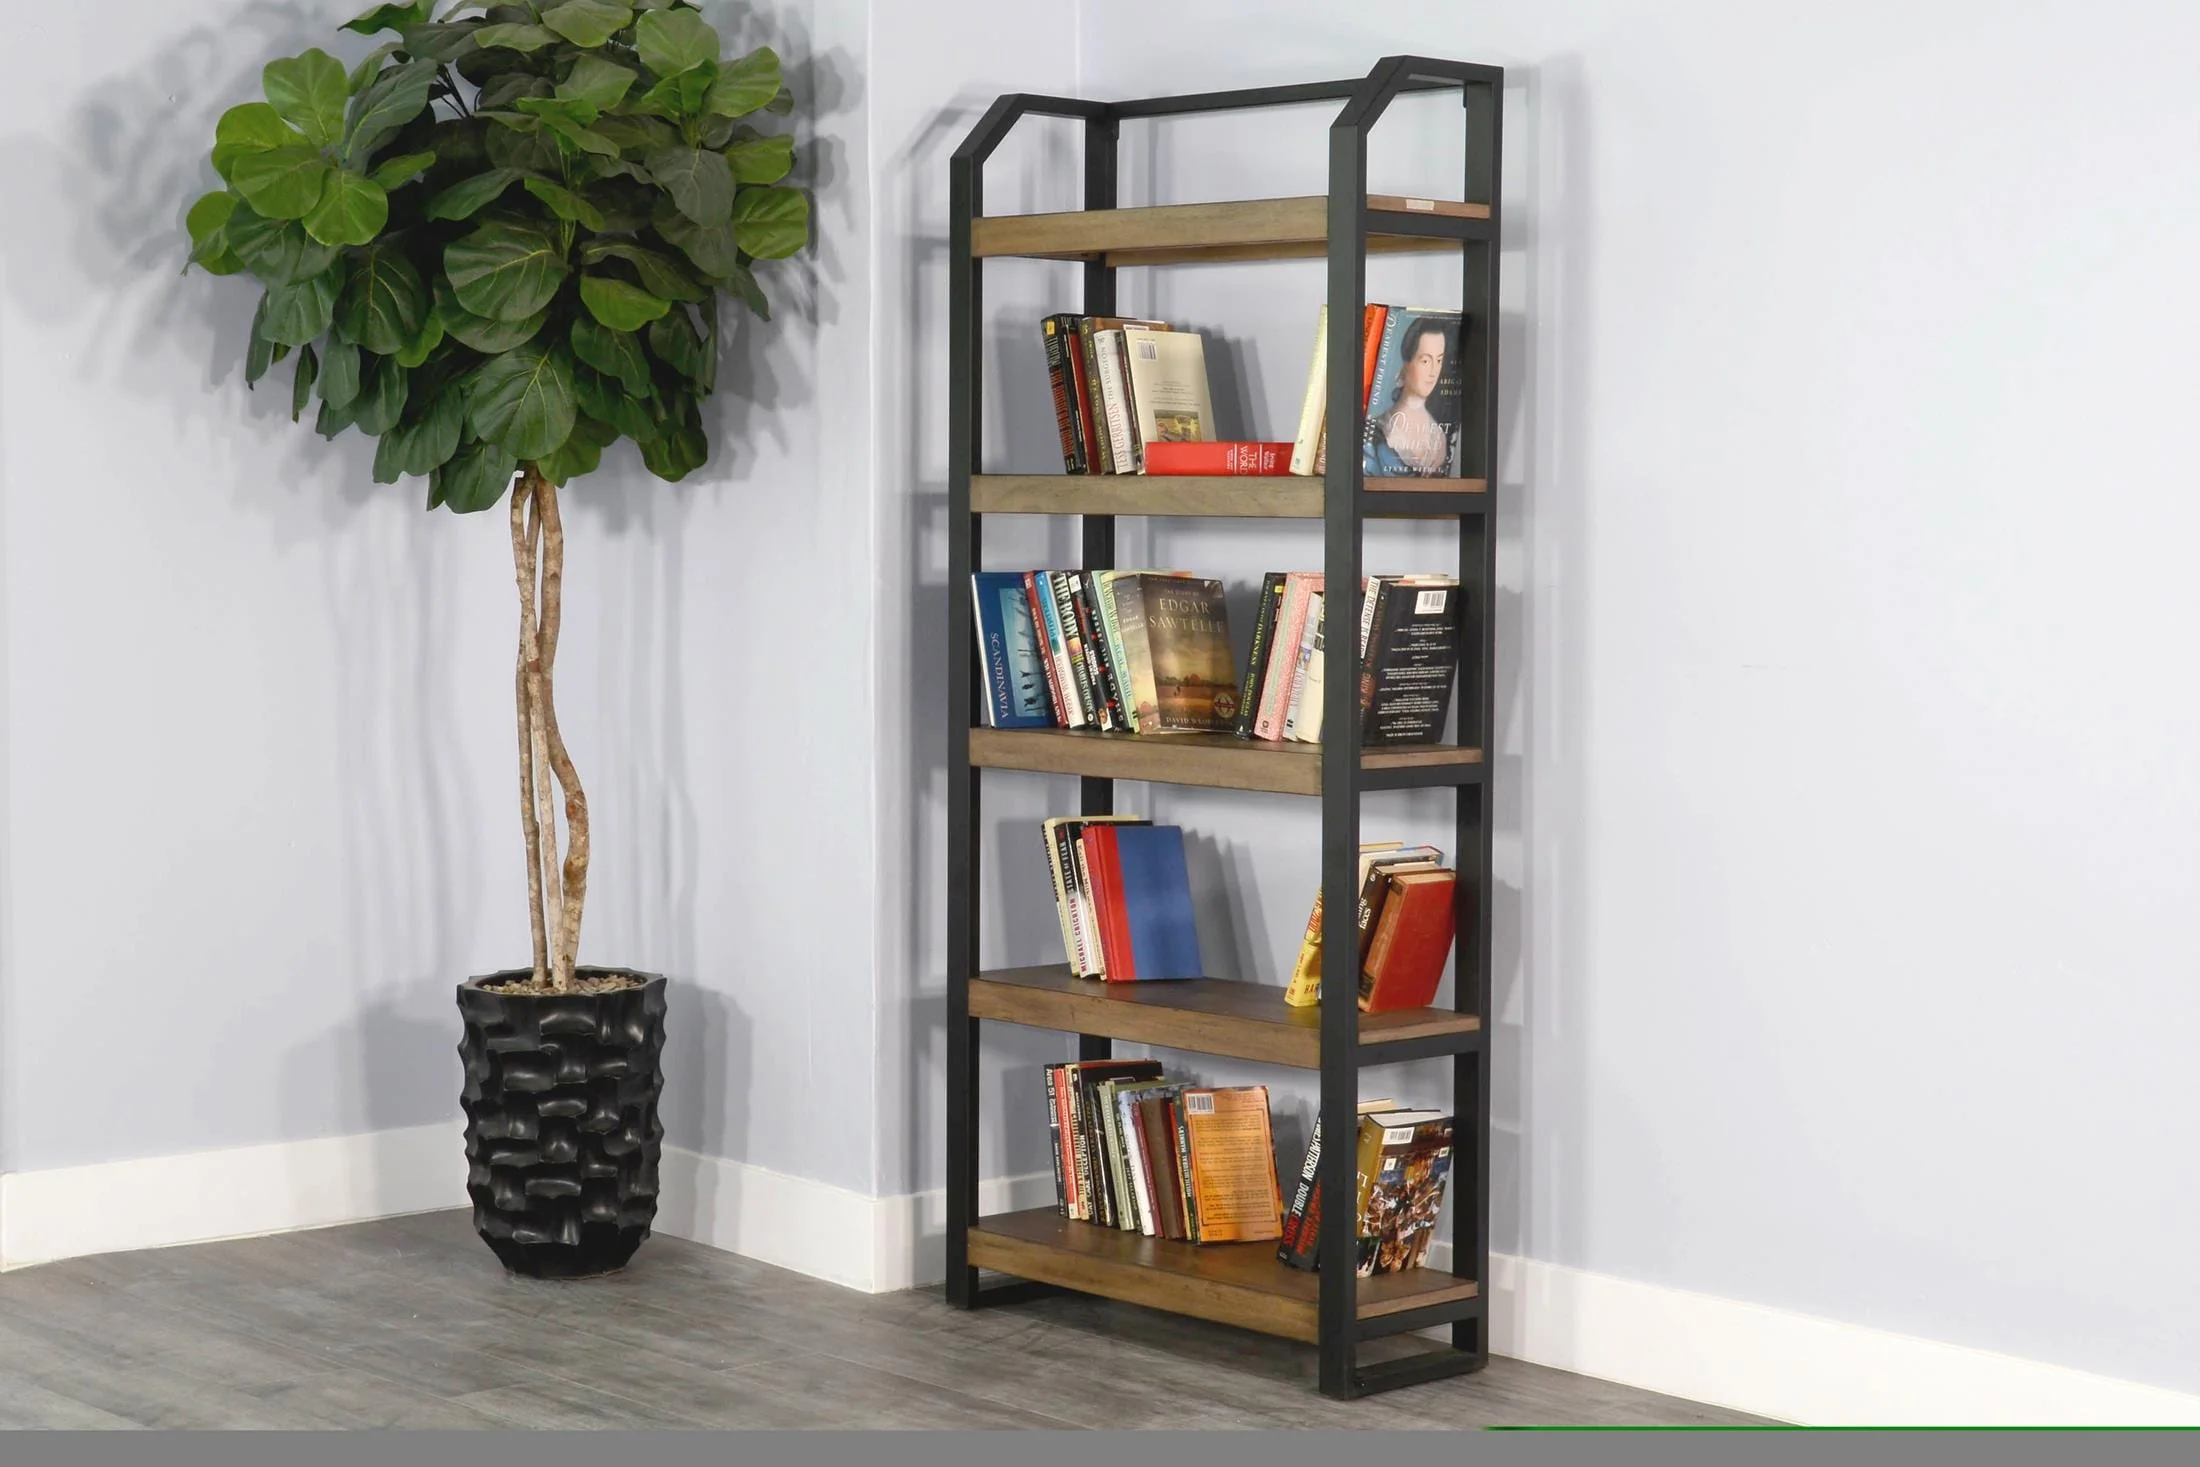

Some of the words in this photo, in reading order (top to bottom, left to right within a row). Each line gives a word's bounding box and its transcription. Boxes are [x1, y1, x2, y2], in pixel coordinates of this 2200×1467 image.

[1052, 572, 1070, 602] THE
[1368, 581, 1378, 593] THE
[1160, 598, 1209, 614] EDGAR
[1362, 595, 1375, 624] DEFENSE
[1149, 615, 1224, 633] SAWTELLE
[991, 631, 1008, 718] SCANDINAVIA
[1048, 1087, 1054, 1095] 51
[1079, 1134, 1088, 1175] DECEPTION
[1300, 1139, 1321, 1181] PATTERSON
[1290, 1182, 1310, 1216] DOUBLE
